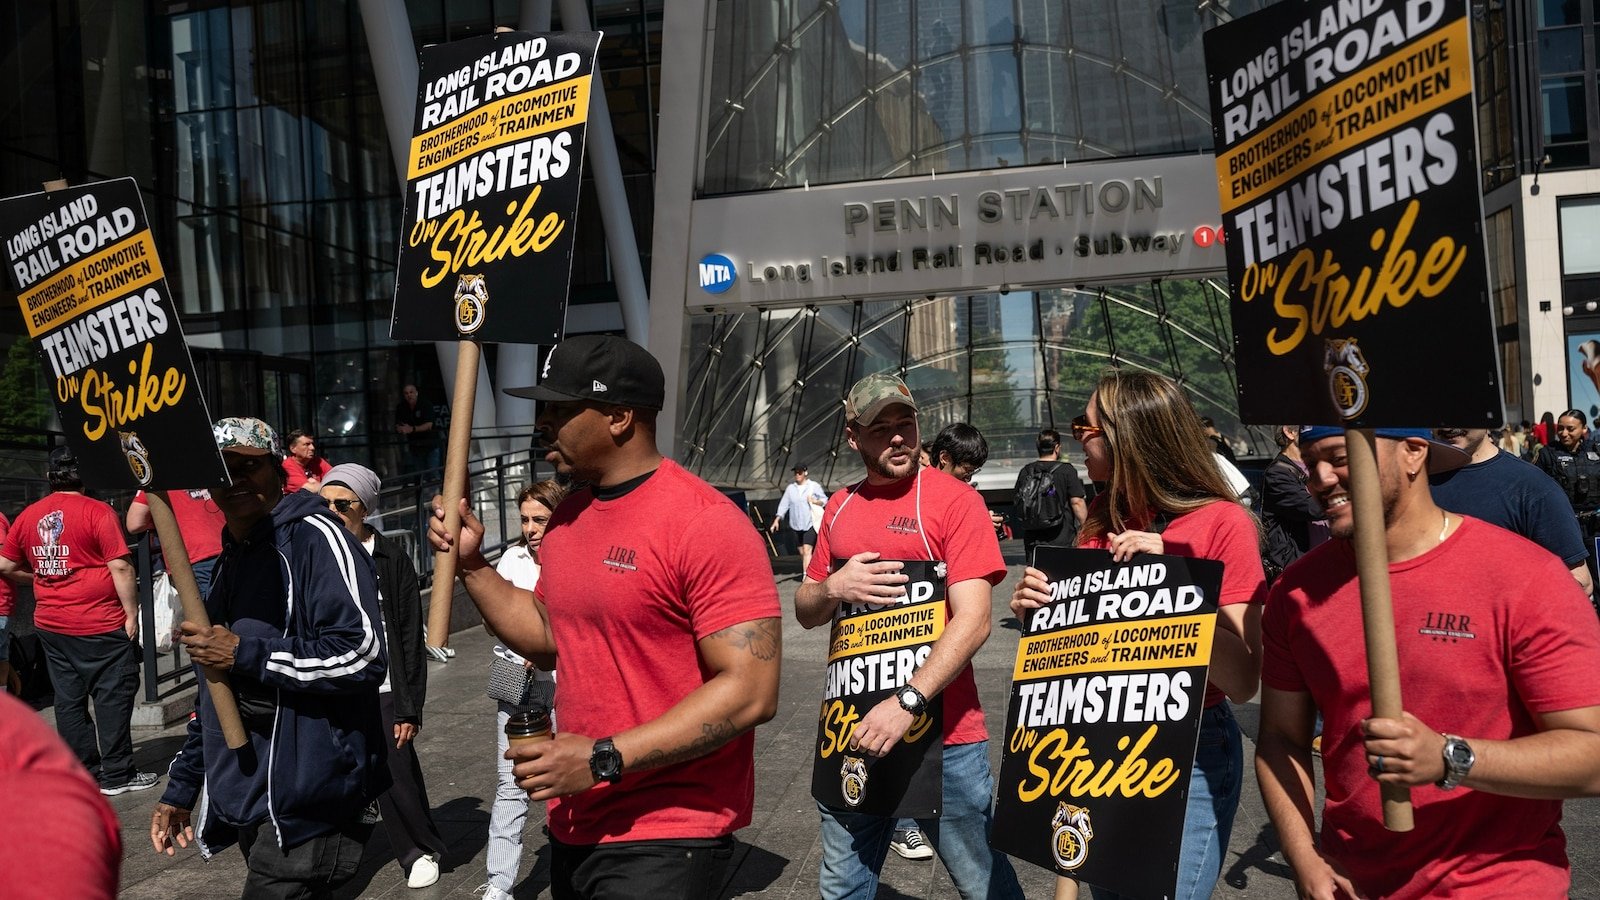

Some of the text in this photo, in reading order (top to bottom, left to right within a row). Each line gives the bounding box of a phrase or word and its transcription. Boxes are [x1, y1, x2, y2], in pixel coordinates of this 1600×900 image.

[421, 52, 581, 130] RAIL ROAD
[425, 37, 547, 103] LONG ISLAND
[1220, 46, 1278, 107] LONG
[1223, 0, 1445, 145] RAIL ROAD
[417, 104, 575, 170] ENGINEERS and TRAINMEN
[420, 85, 578, 153] BROTHERHOOD of LOCOMOTIVE
[1229, 38, 1449, 176] BROTHERHOOD of LOCOMOTIVE
[1231, 67, 1450, 199] ENGINEERS and TRAINMEN
[415, 131, 572, 222] TEAMSTERS
[843, 177, 1164, 235] PENN STATION
[1235, 112, 1458, 269] TEAMSTERS
[6, 193, 98, 261] LONG ISLAND
[13, 206, 136, 288] RAIL ROAD
[410, 184, 565, 289] On Strike
[747, 261, 811, 284] Long
[822, 249, 902, 278] Island
[912, 245, 963, 271] Rail
[974, 238, 1045, 266] Road
[1073, 230, 1186, 258] Subway
[27, 240, 146, 311] BROTHERHOOD of LOCOMOTIVE
[32, 294, 78, 329] ENGINEERS
[87, 259, 152, 299] TRAINMEN
[699, 263, 731, 287] MTA
[1241, 200, 1467, 356] On Strike
[41, 287, 168, 379] TEAMSTERS
[57, 342, 186, 441] On Strike
[607, 545, 636, 564] LIRR
[1049, 563, 1167, 602] ONG ISLAND
[850, 637, 864, 648] and
[865, 624, 934, 646] TRAINMEN
[857, 623, 864, 637] of
[865, 608, 935, 631] LOCOMOTIVE
[1026, 623, 1201, 655] BROTHERHOOD of LOCOMOTIVE
[1030, 585, 1205, 632] RAIL ROAD
[1425, 612, 1471, 631] LIRR
[825, 645, 932, 700] EAMSTERS
[1022, 642, 1197, 673] ENGINEERS and TRAINMEN
[820, 699, 933, 760] Ste
[1017, 671, 1192, 728] TEAMSTERS
[1010, 723, 1180, 803] On Strike
